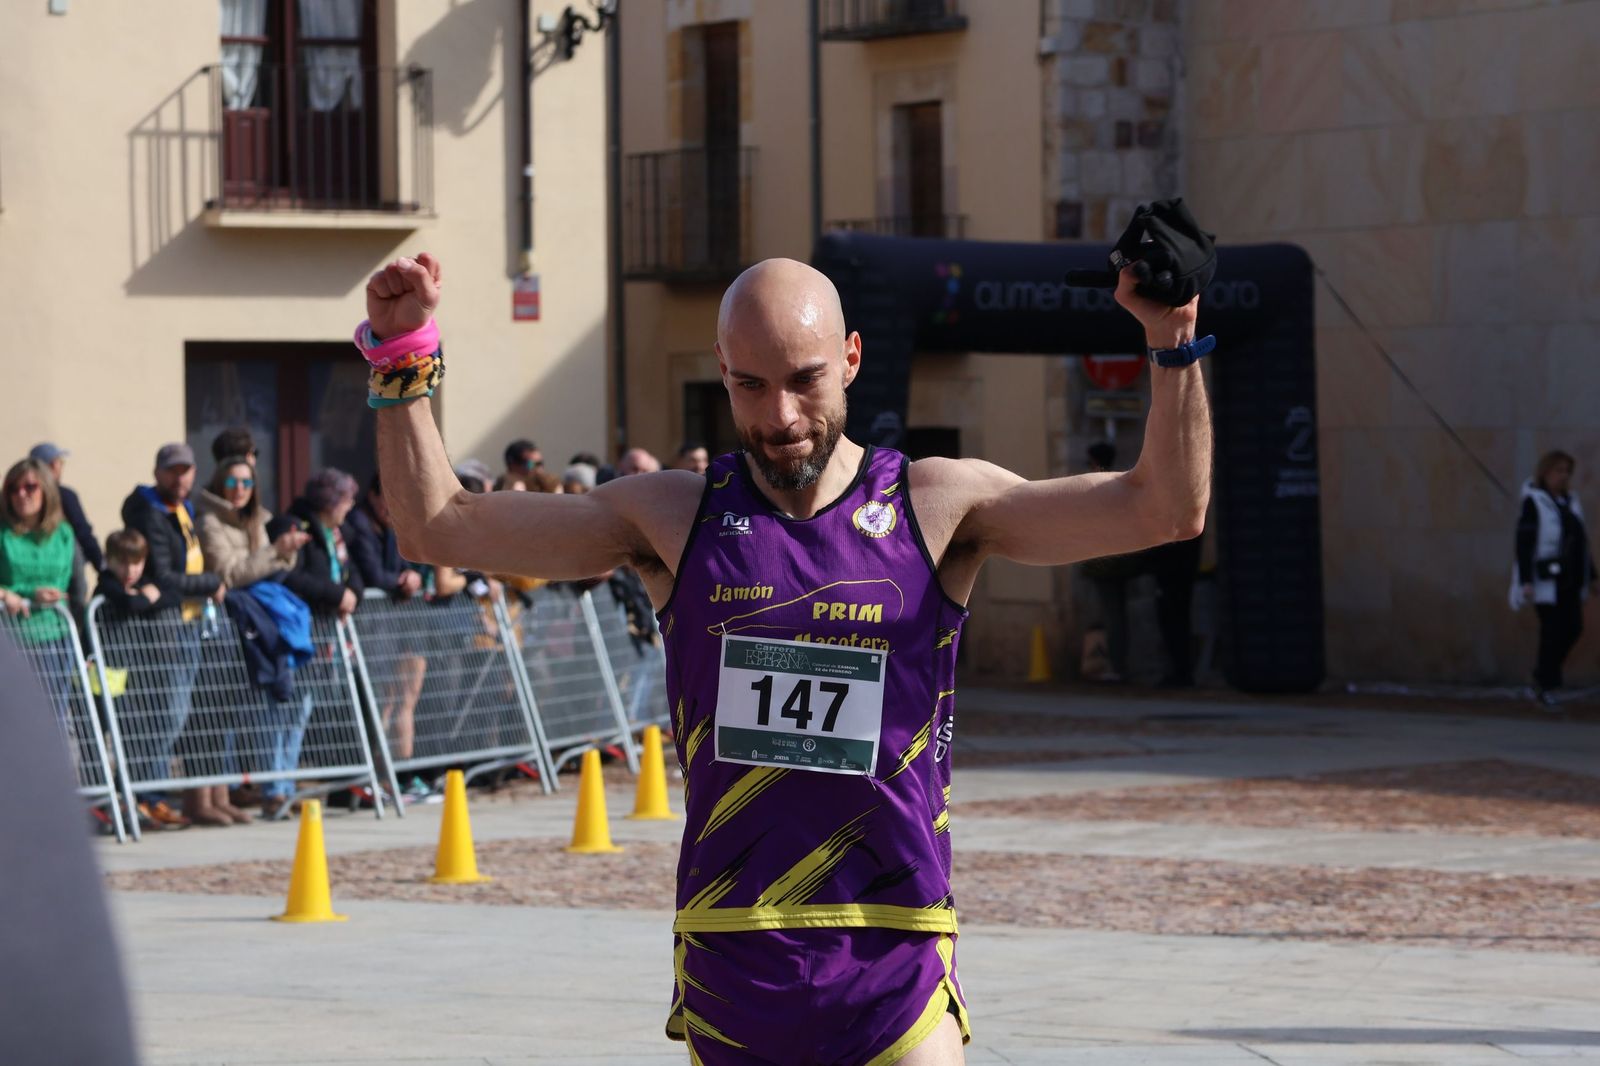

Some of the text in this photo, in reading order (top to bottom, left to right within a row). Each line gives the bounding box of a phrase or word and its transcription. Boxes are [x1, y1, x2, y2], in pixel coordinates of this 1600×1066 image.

[709, 581, 774, 603] Jamón
[812, 602, 883, 623] PRIM
[755, 643, 796, 654] Carrera
[751, 675, 850, 732] 147
